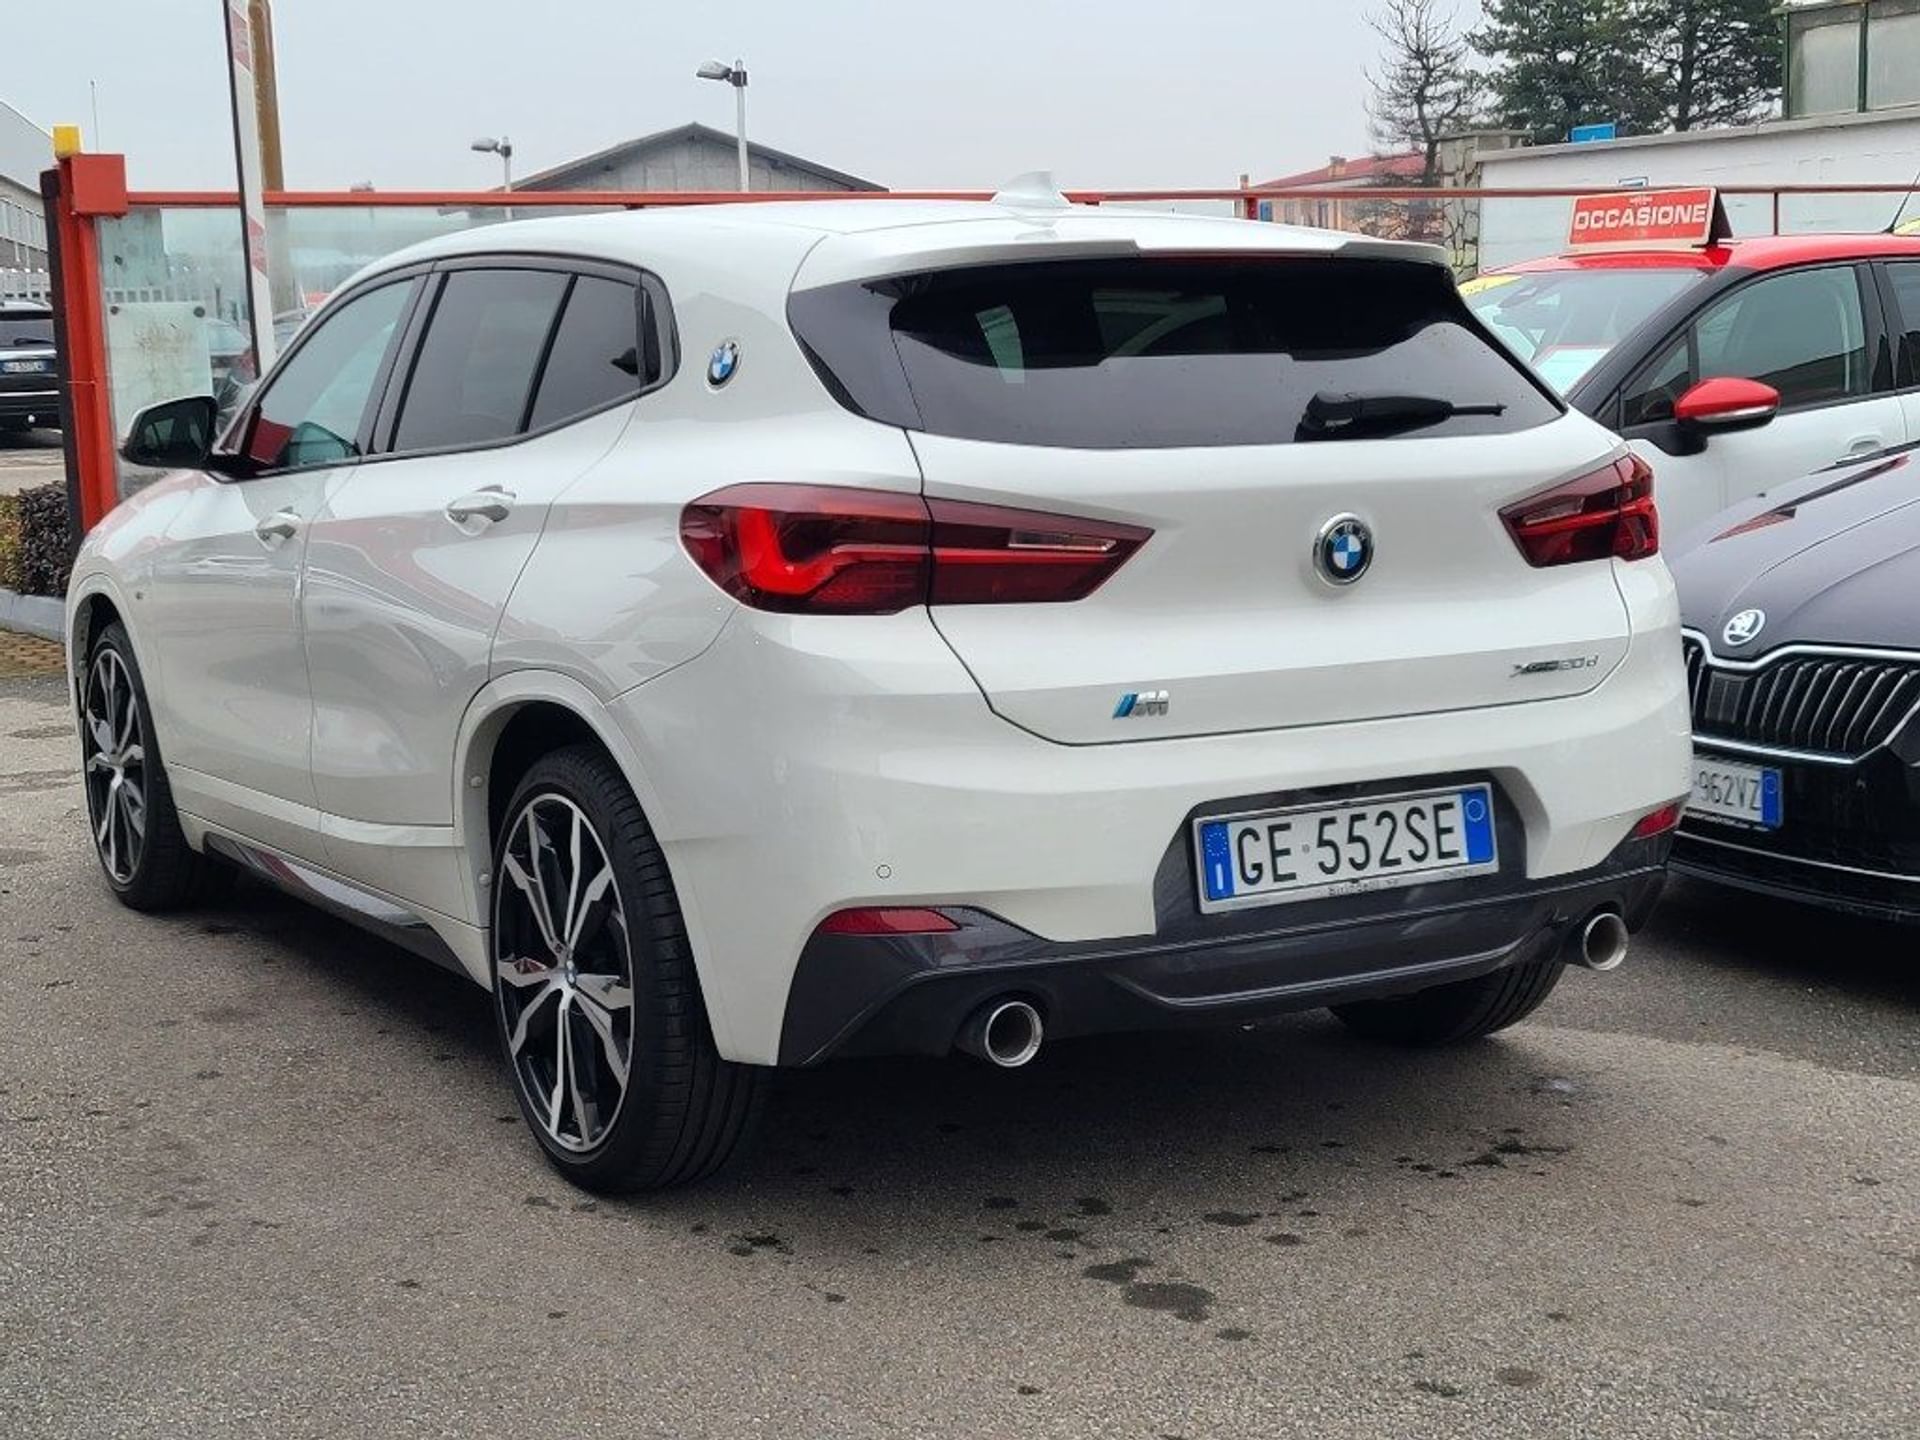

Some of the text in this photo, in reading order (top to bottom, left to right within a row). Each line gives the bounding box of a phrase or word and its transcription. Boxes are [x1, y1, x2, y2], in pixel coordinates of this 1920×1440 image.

[1574, 204, 1707, 230] OCCASIONE
[1237, 801, 1460, 886] GE 552SE
